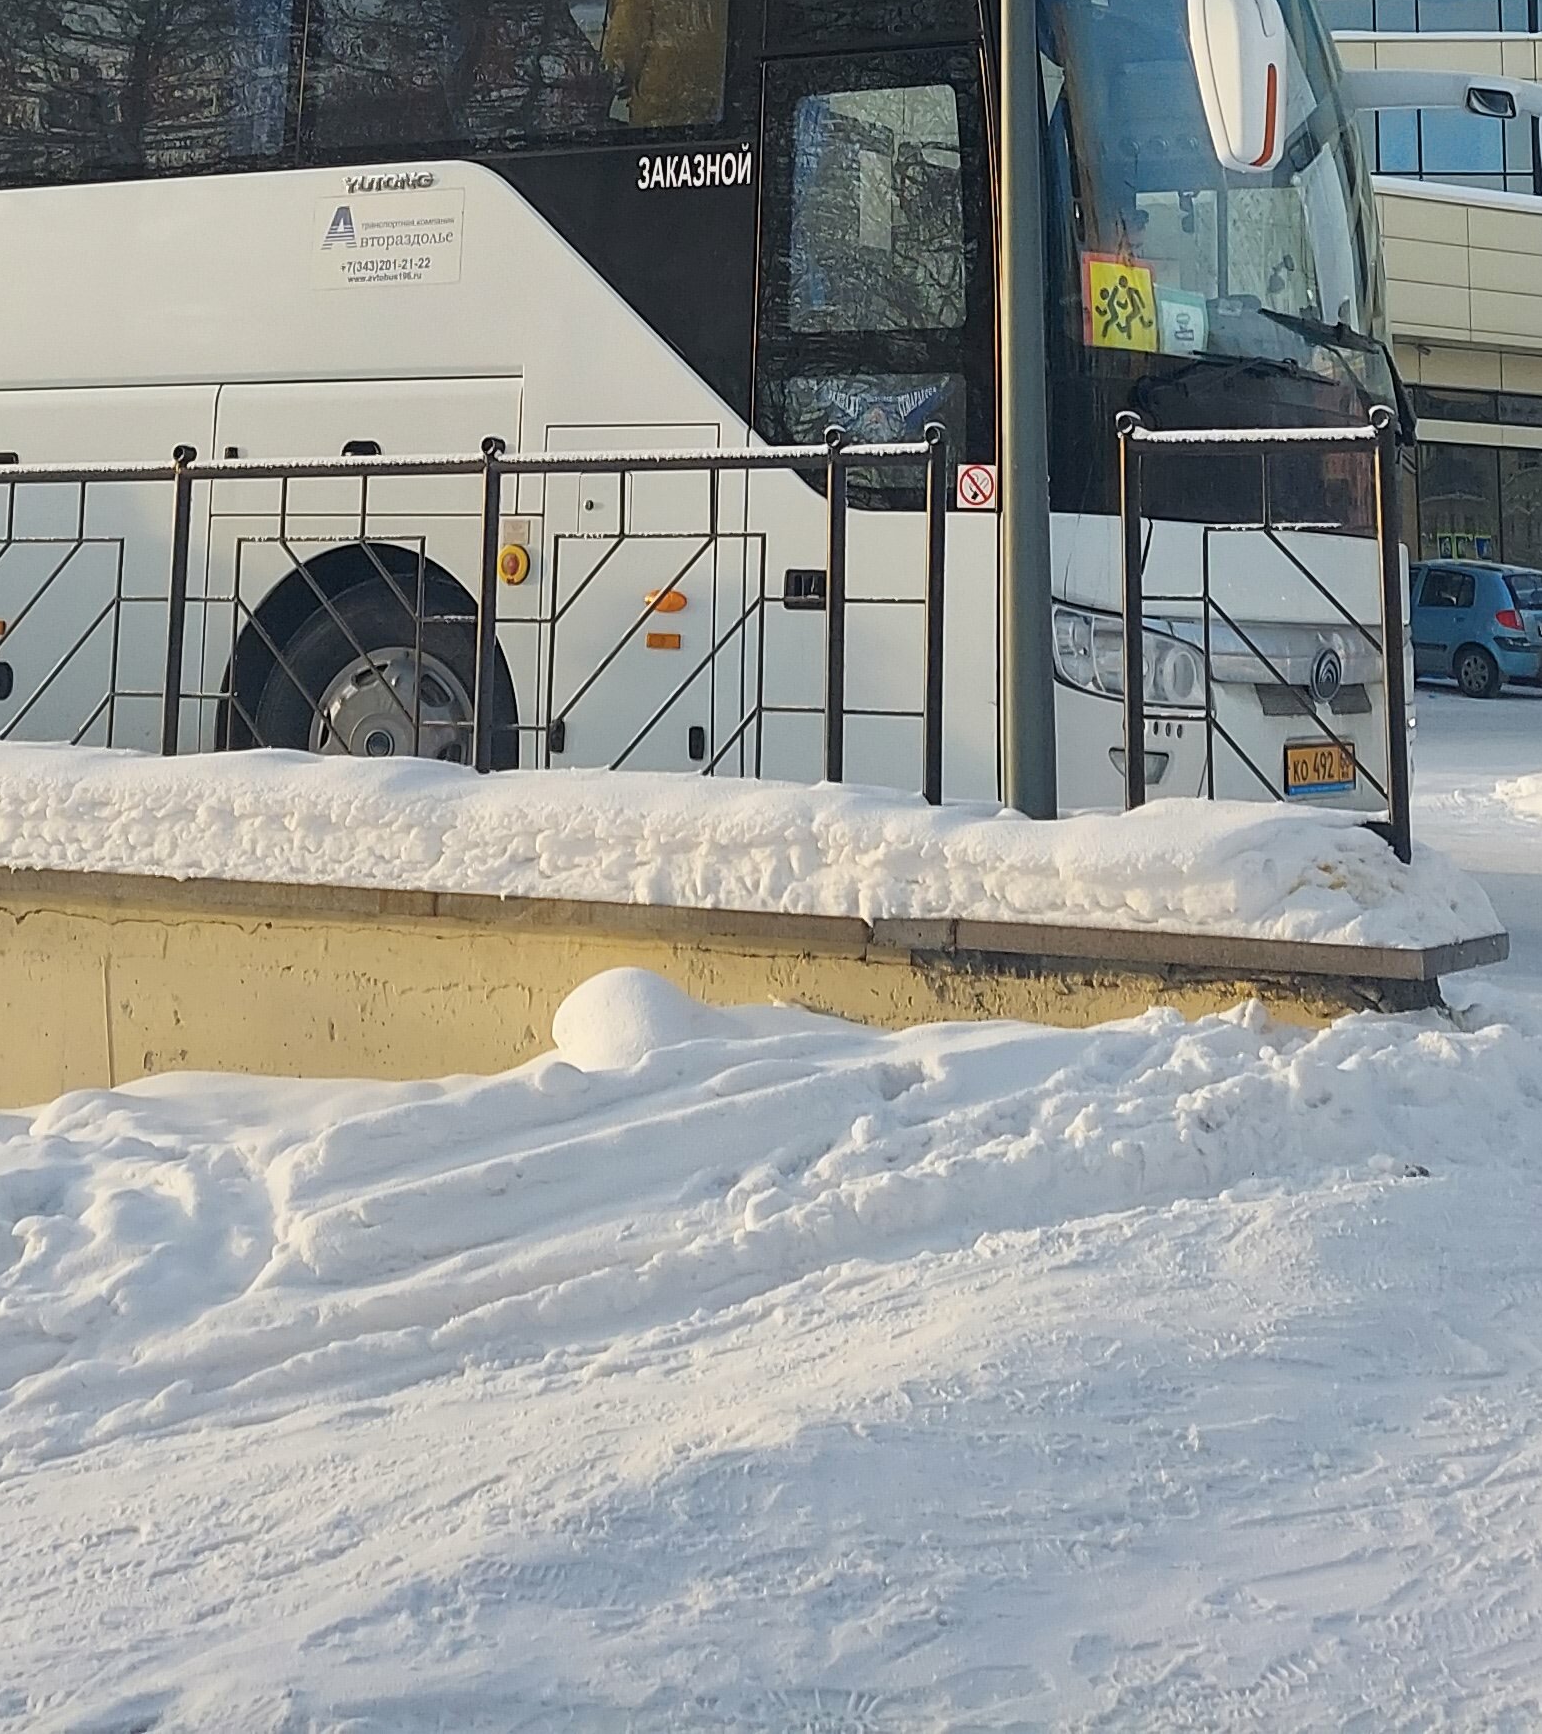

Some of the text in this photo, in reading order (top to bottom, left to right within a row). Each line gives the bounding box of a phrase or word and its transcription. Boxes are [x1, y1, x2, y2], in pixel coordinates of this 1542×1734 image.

[637, 142, 752, 190] ЗАКАЗНОЙ
[345, 171, 434, 193] YUTONG
[1313, 751, 1334, 780] 492
